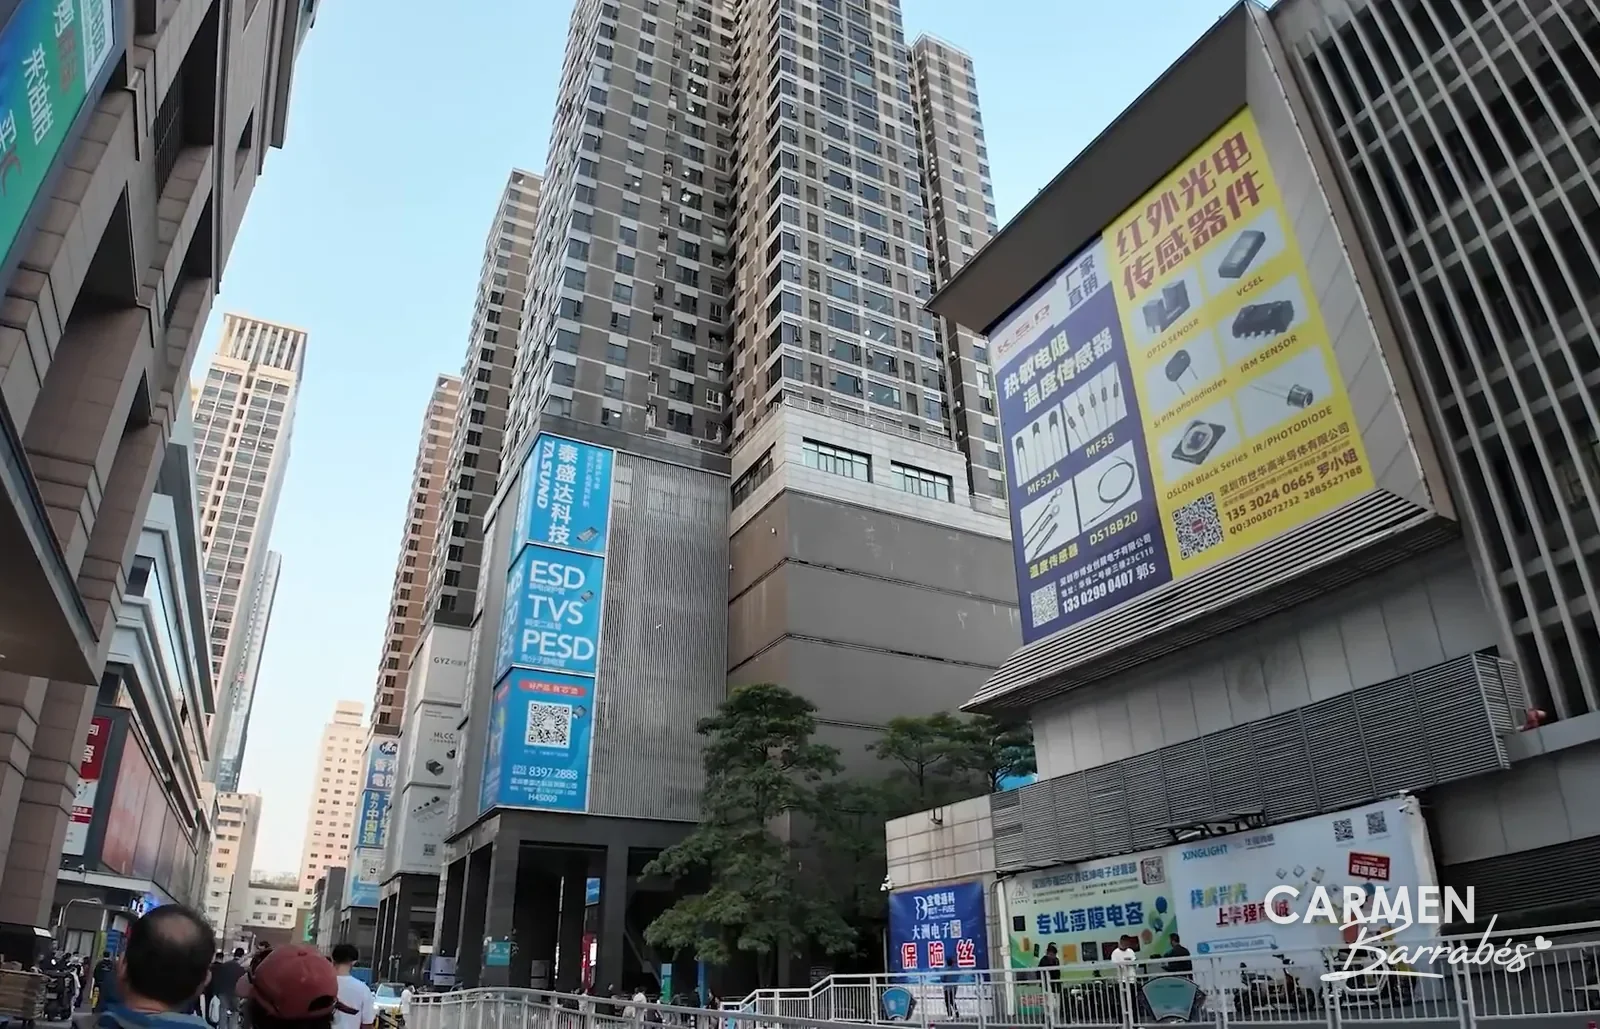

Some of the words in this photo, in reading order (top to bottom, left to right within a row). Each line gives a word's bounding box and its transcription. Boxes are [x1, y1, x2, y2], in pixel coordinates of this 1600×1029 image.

[1116, 131, 1252, 264] 红外光电
[1123, 170, 1264, 301] 传感器件
[1066, 254, 1095, 291] 厂家
[1236, 275, 1264, 296] VCSEL
[1068, 272, 1098, 311] 直销
[1004, 330, 1070, 399] 热敏电阻
[1146, 339, 1168, 359] OPTO
[1240, 357, 1258, 373] IRM
[1259, 334, 1298, 363] SENSOR
[1023, 326, 1113, 413] 温度传感器
[1162, 410, 1175, 423] PIN
[1175, 377, 1228, 416] photodiodes
[1085, 432, 1115, 458] MF58
[537, 440, 555, 509] TASUND
[1027, 469, 1060, 496] MF52A
[1166, 481, 1195, 500] OSLON
[1196, 467, 1220, 485] Black
[1220, 452, 1249, 471] Series
[1225, 503, 1247, 522] 135
[1249, 488, 1280, 513] 3024
[1282, 472, 1315, 496] 0665
[1316, 448, 1359, 478] 罗小姐
[548, 443, 578, 546] 泰盛达科技
[1089, 511, 1139, 546] DS18B20
[530, 560, 585, 590] ESD
[1062, 596, 1080, 614] 133
[1080, 583, 1107, 606] 0299
[1107, 569, 1134, 594] 0407
[528, 594, 584, 625] TVS
[522, 628, 595, 660] PESD
[528, 765, 553, 778] 8397
[1182, 844, 1228, 860] XINGLIGHT
[1036, 901, 1144, 935] 专业薄膜电容
[901, 939, 976, 969] 保险丝
